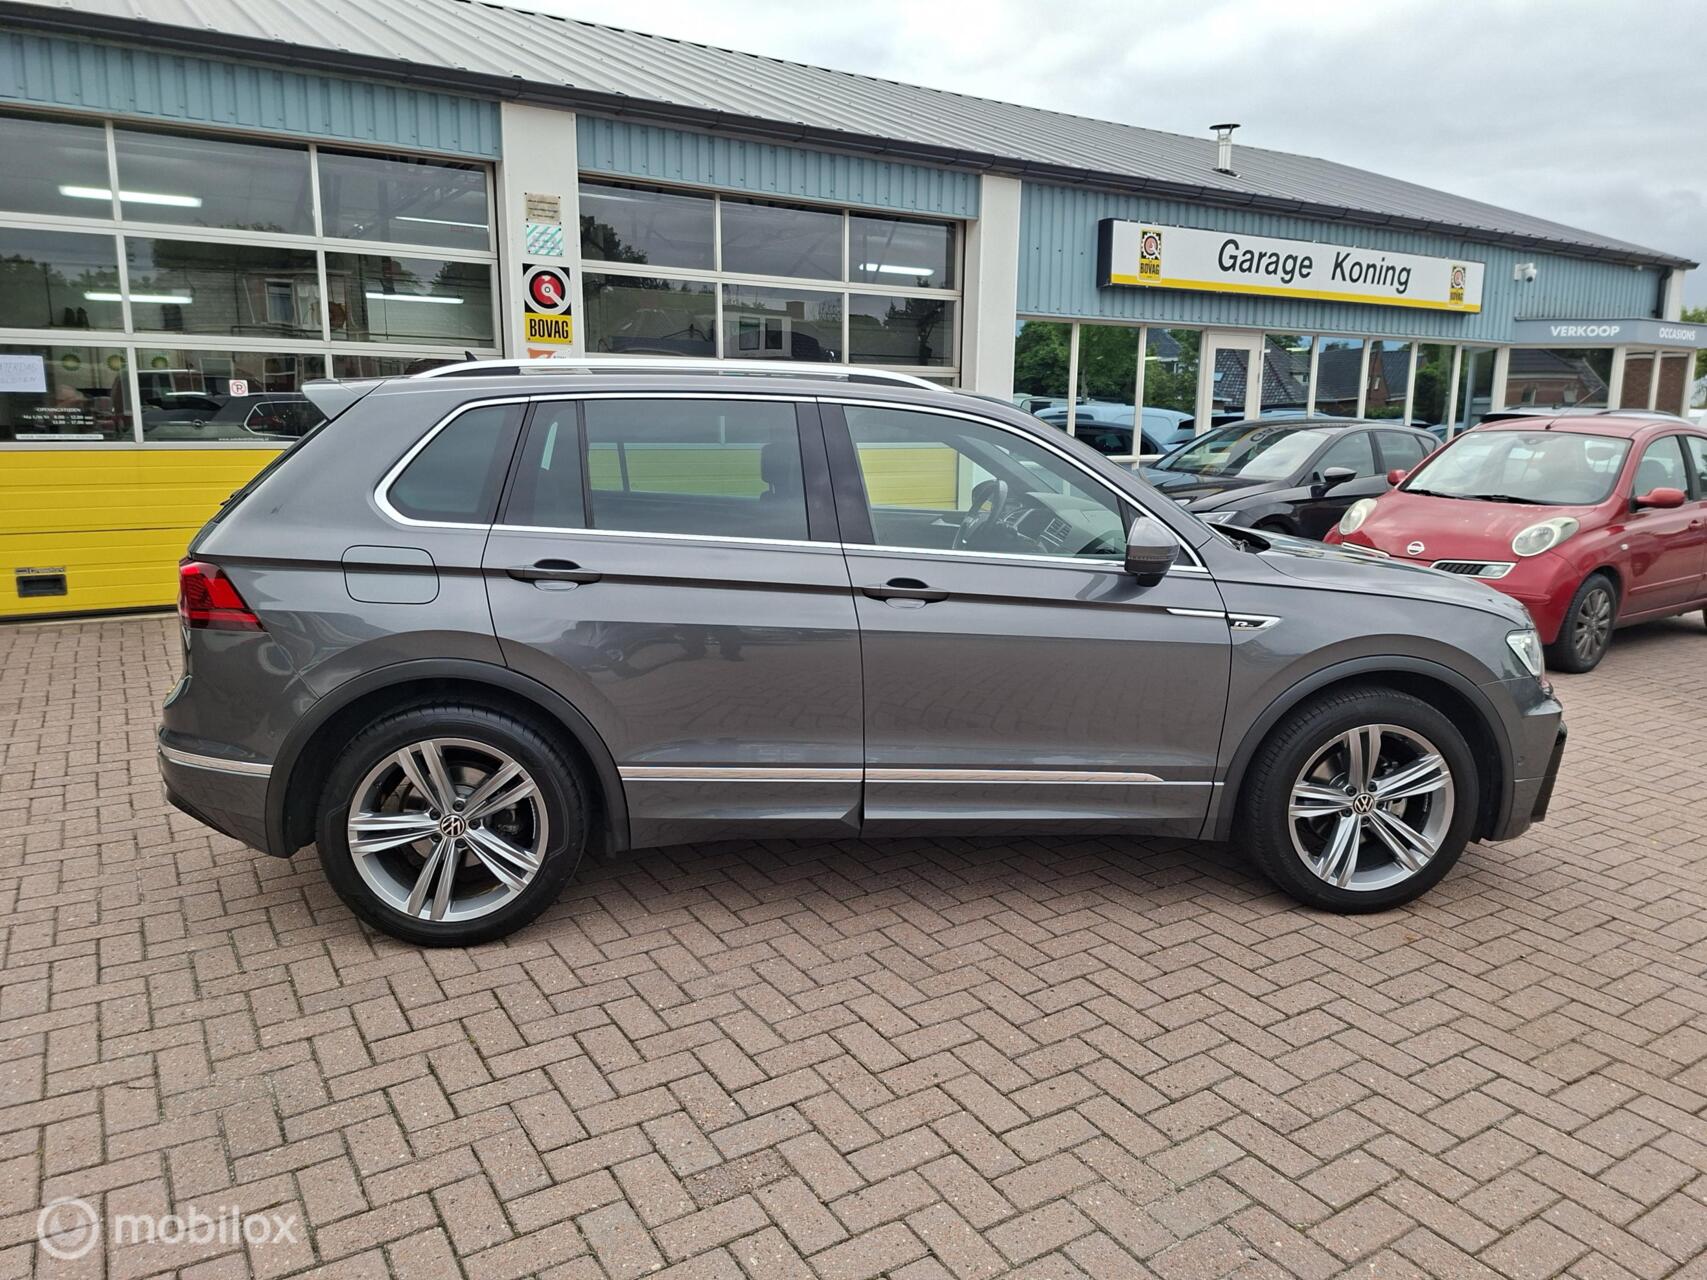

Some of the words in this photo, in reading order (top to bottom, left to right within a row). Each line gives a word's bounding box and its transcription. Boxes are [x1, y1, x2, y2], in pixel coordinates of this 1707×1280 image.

[1139, 262, 1160, 275] BOVAG
[1218, 239, 1313, 284] Garage
[1332, 252, 1412, 294] Koning
[529, 318, 569, 339] BOVAG
[1551, 325, 1620, 337] VERKOOP
[1659, 327, 1696, 341] OCCASIONS
